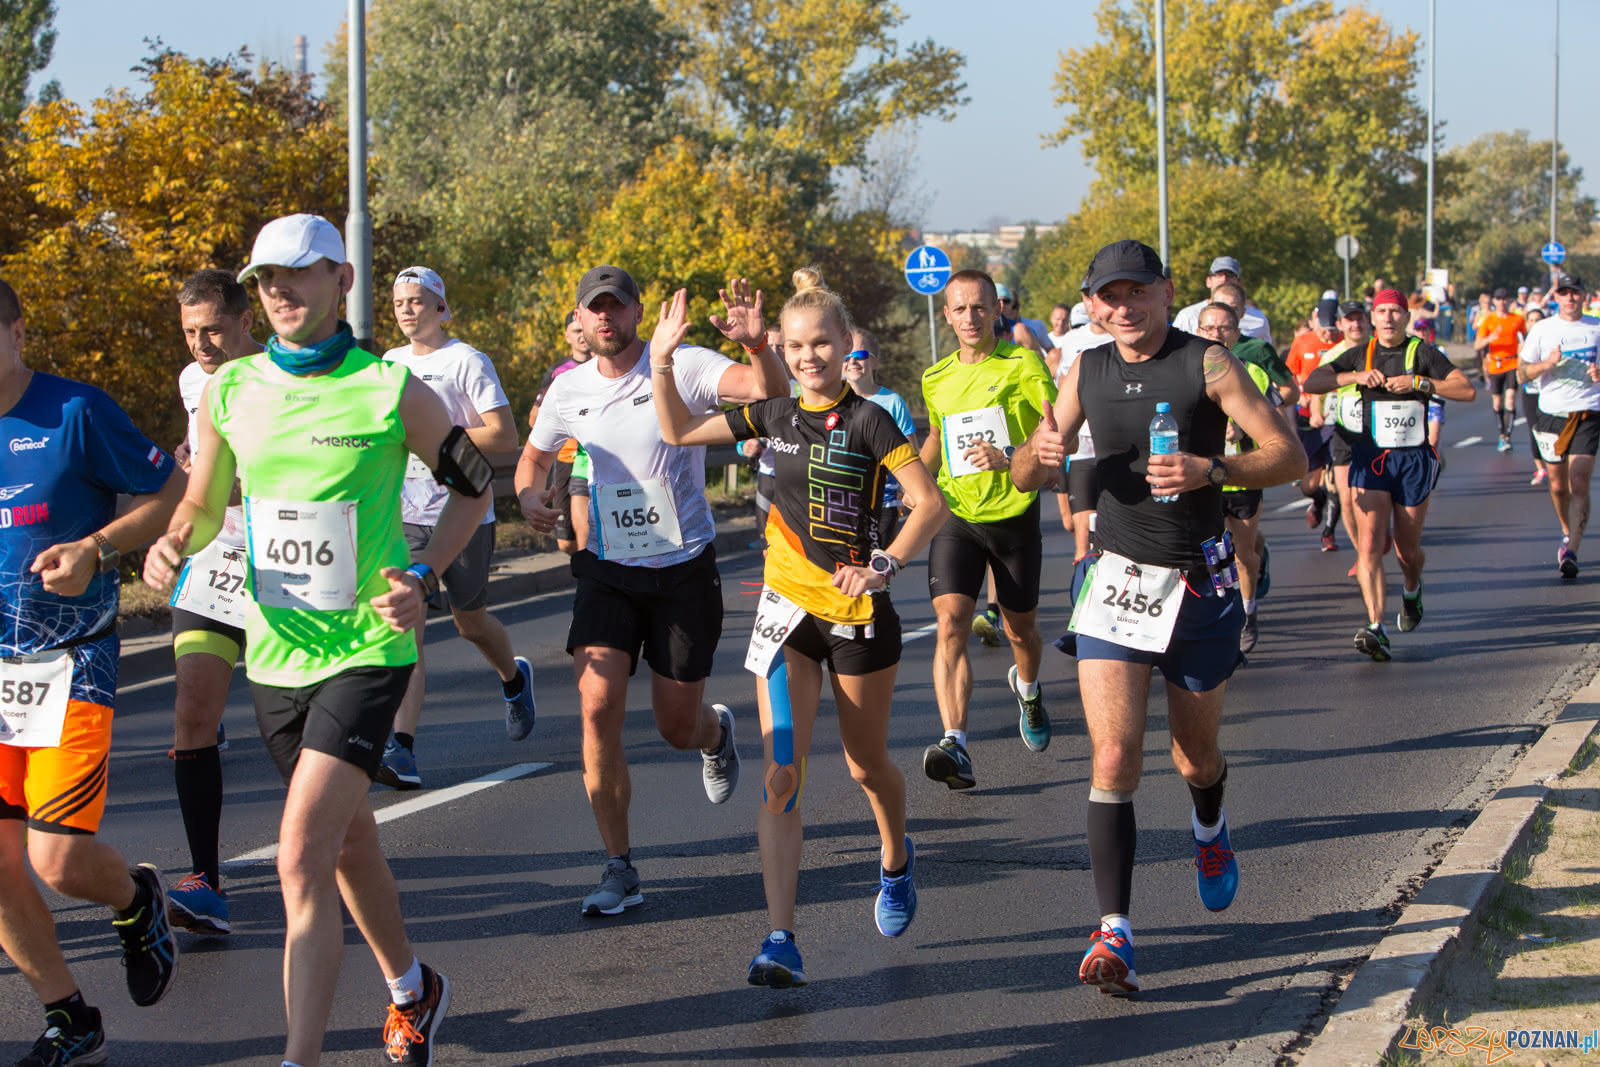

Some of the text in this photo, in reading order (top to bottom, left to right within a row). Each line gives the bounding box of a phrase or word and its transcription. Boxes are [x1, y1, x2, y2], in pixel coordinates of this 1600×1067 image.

[1384, 417, 1416, 428] 3940
[13, 437, 46, 452] Benecol
[611, 506, 660, 529] 1656
[266, 538, 334, 566] 4016
[217, 594, 233, 604] Piotr
[1102, 584, 1163, 618] 2456
[1, 679, 51, 706] 587
